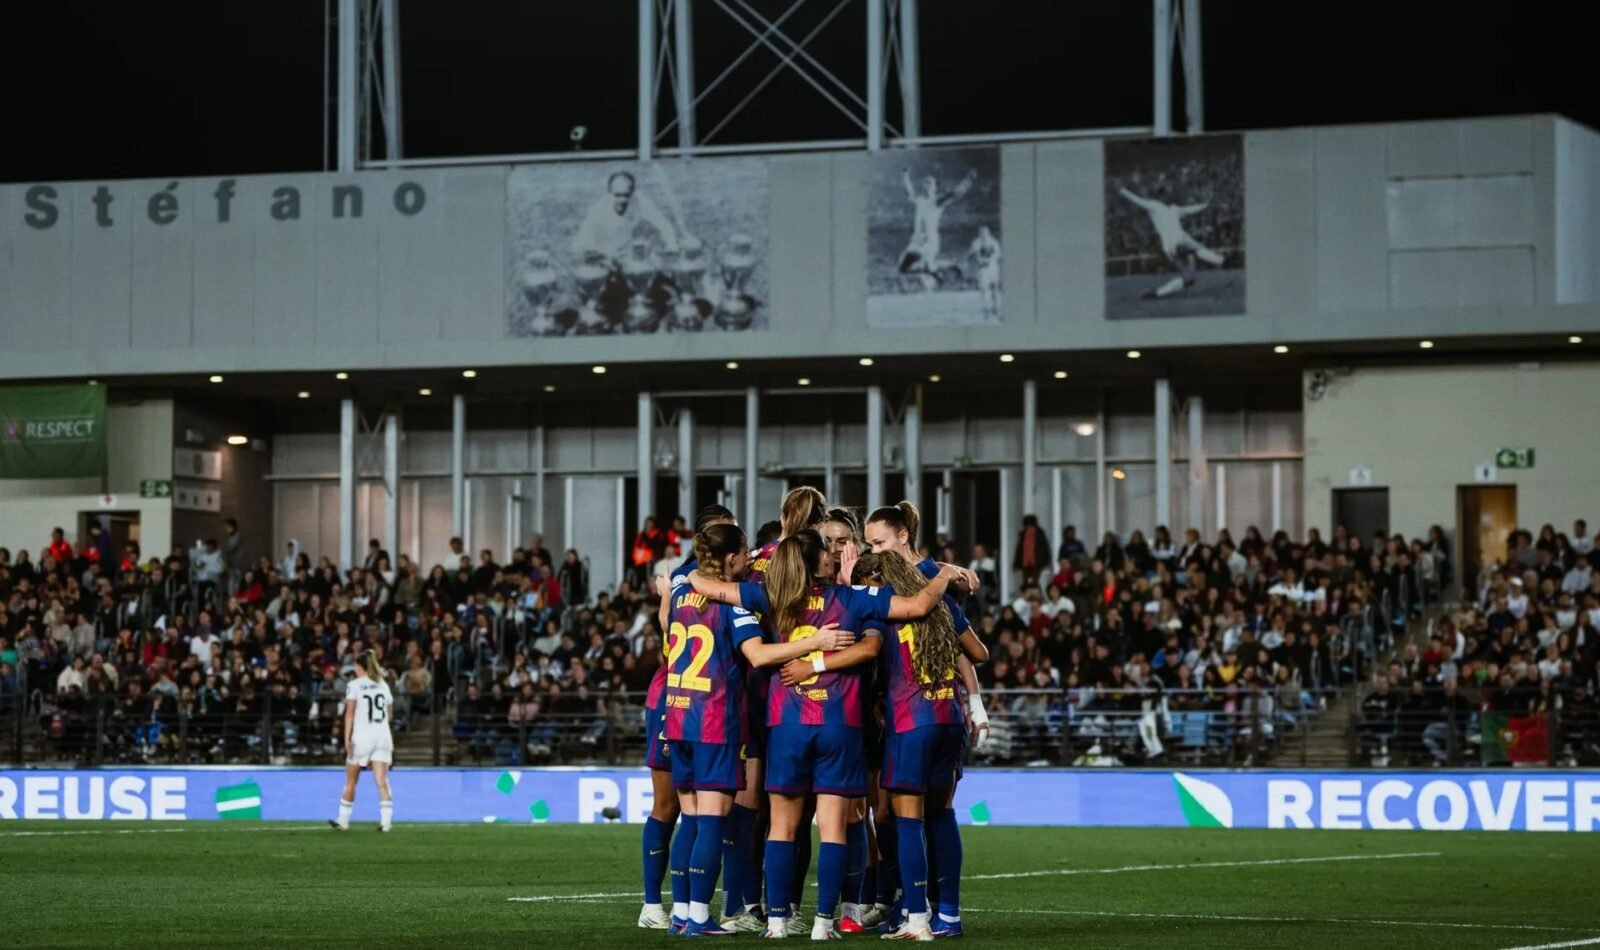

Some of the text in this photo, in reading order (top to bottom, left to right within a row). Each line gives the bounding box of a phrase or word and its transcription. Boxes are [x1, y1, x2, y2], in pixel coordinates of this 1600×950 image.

[24, 179, 427, 230] Stéfano
[26, 420, 95, 438] RESPECT
[667, 622, 715, 692] 22
[363, 693, 386, 724] 19
[1267, 780, 1600, 831] RECOVER
